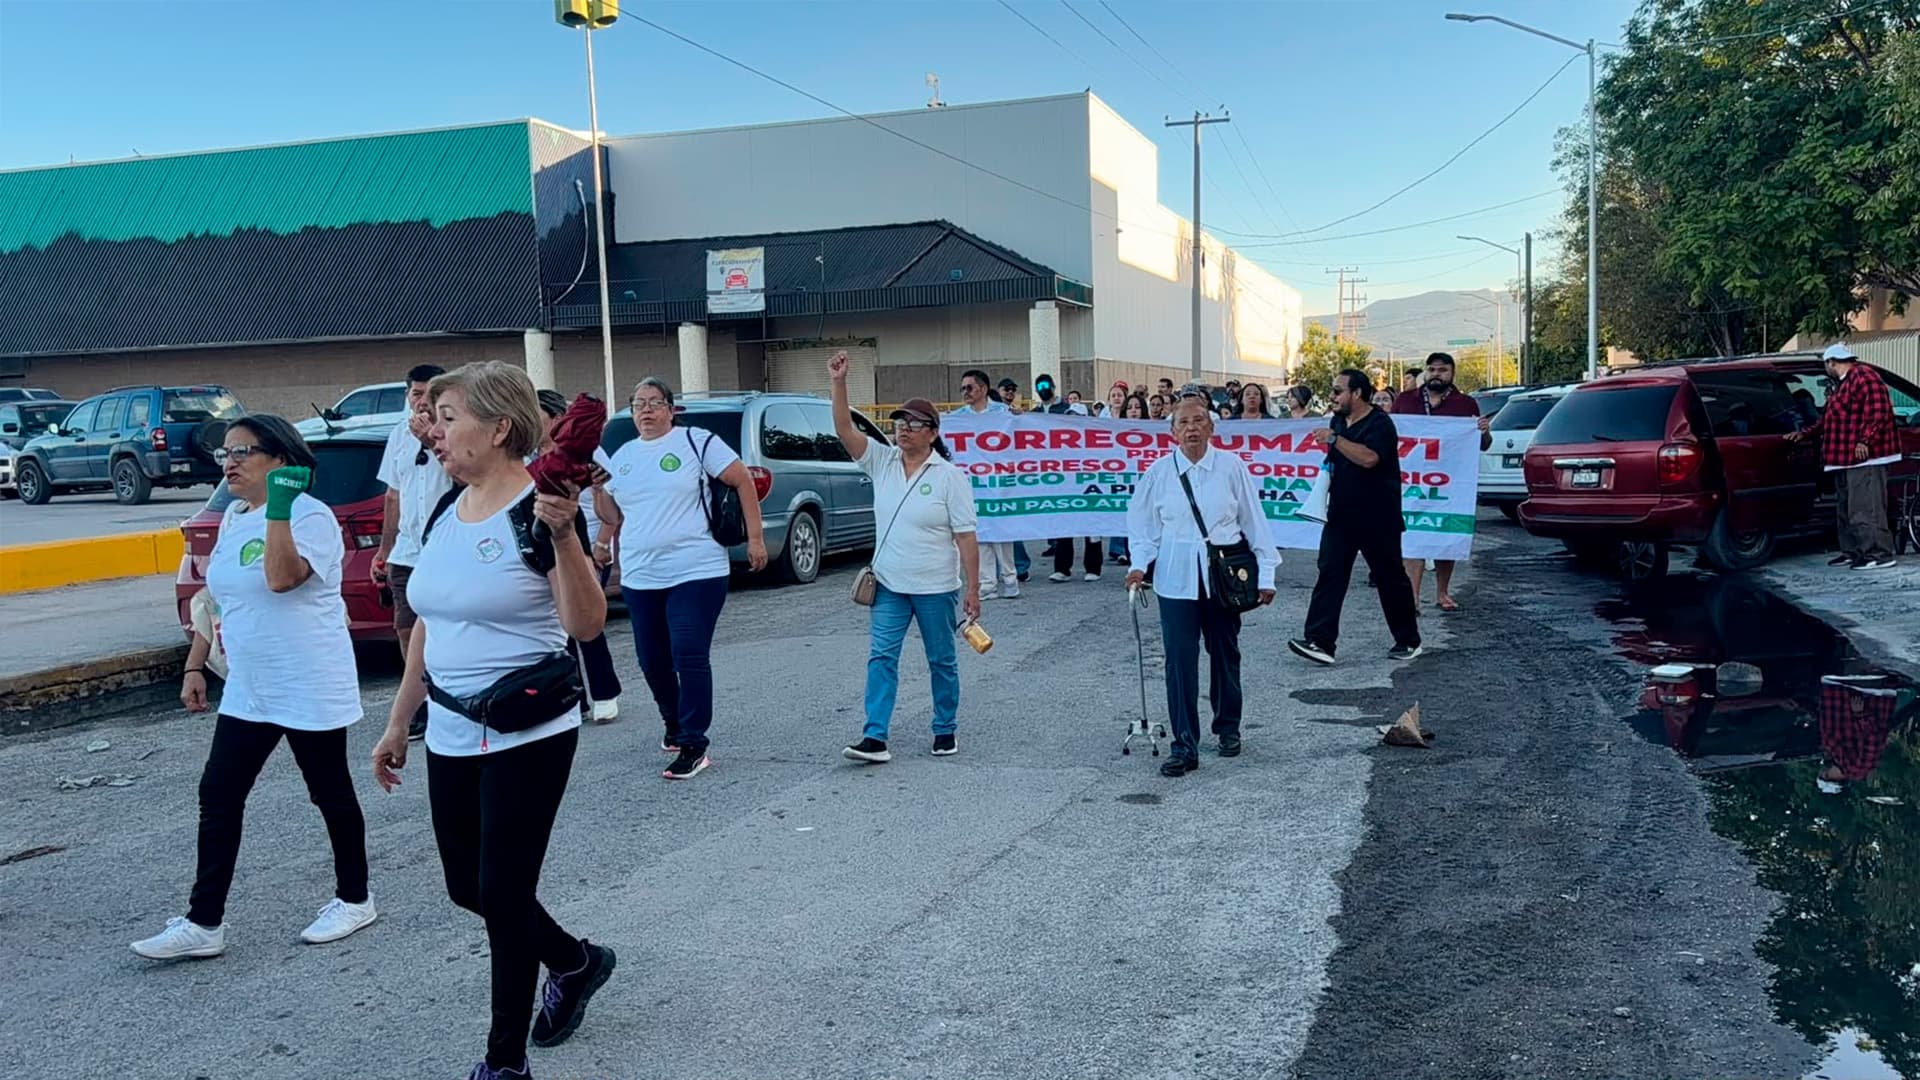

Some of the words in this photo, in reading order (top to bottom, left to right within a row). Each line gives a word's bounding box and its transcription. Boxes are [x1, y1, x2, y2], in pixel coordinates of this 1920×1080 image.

[944, 429, 1180, 452] TORREÓN
[969, 472, 1065, 489] LIEGO
[1083, 484, 1104, 495] A
[986, 501, 1017, 513] UN
[1025, 498, 1088, 511] PASO
